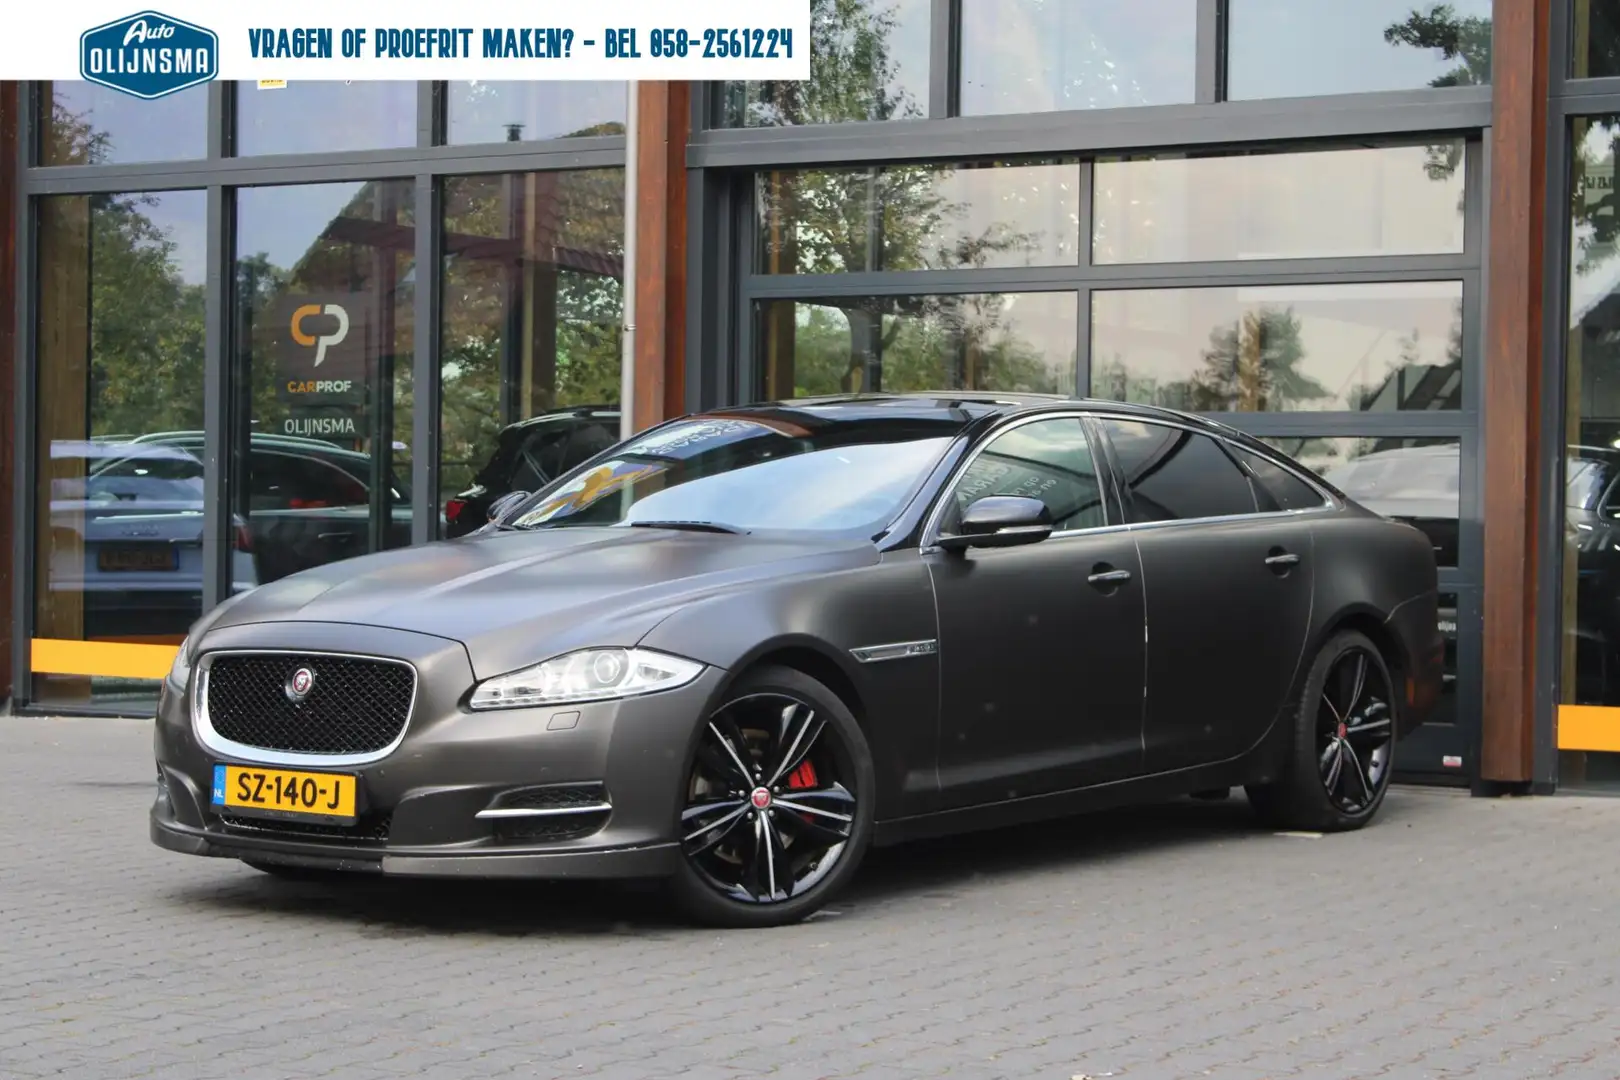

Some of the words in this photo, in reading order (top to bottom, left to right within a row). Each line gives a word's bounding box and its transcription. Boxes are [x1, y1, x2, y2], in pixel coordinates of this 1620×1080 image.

[287, 380, 352, 393] CARPROF
[284, 418, 356, 436] OLIJNSMA
[214, 788, 223, 798] NL
[237, 772, 340, 810] SZ-140-J
